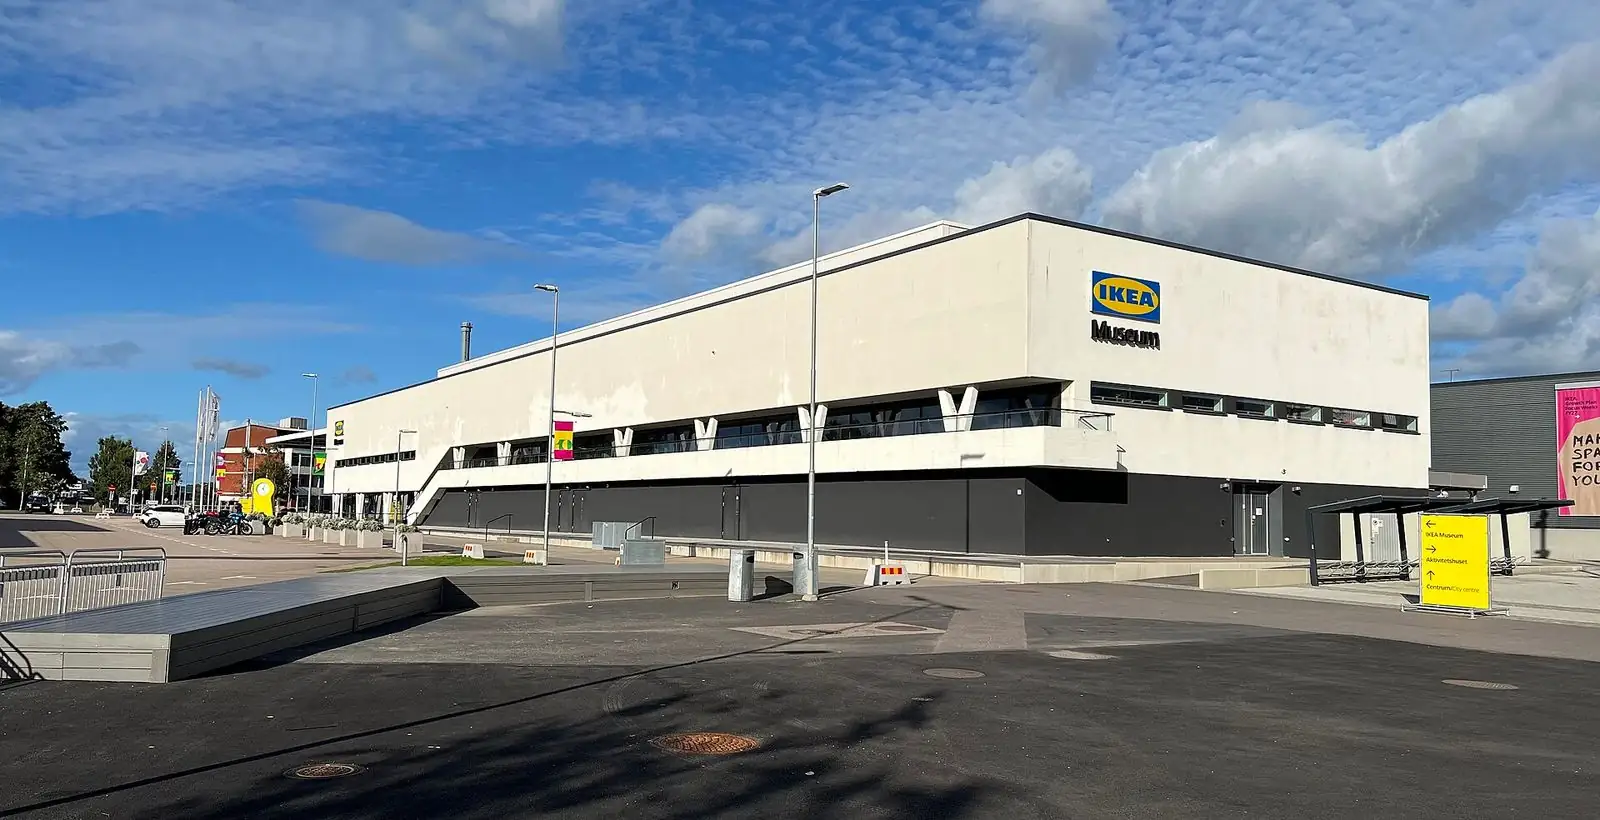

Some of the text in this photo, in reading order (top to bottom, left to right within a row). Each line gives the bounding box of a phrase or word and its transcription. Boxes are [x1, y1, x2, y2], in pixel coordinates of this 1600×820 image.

[1099, 284, 1154, 307] IKEA
[1091, 319, 1160, 349] Museum
[1425, 557, 1468, 565] Aktivitetshuset
